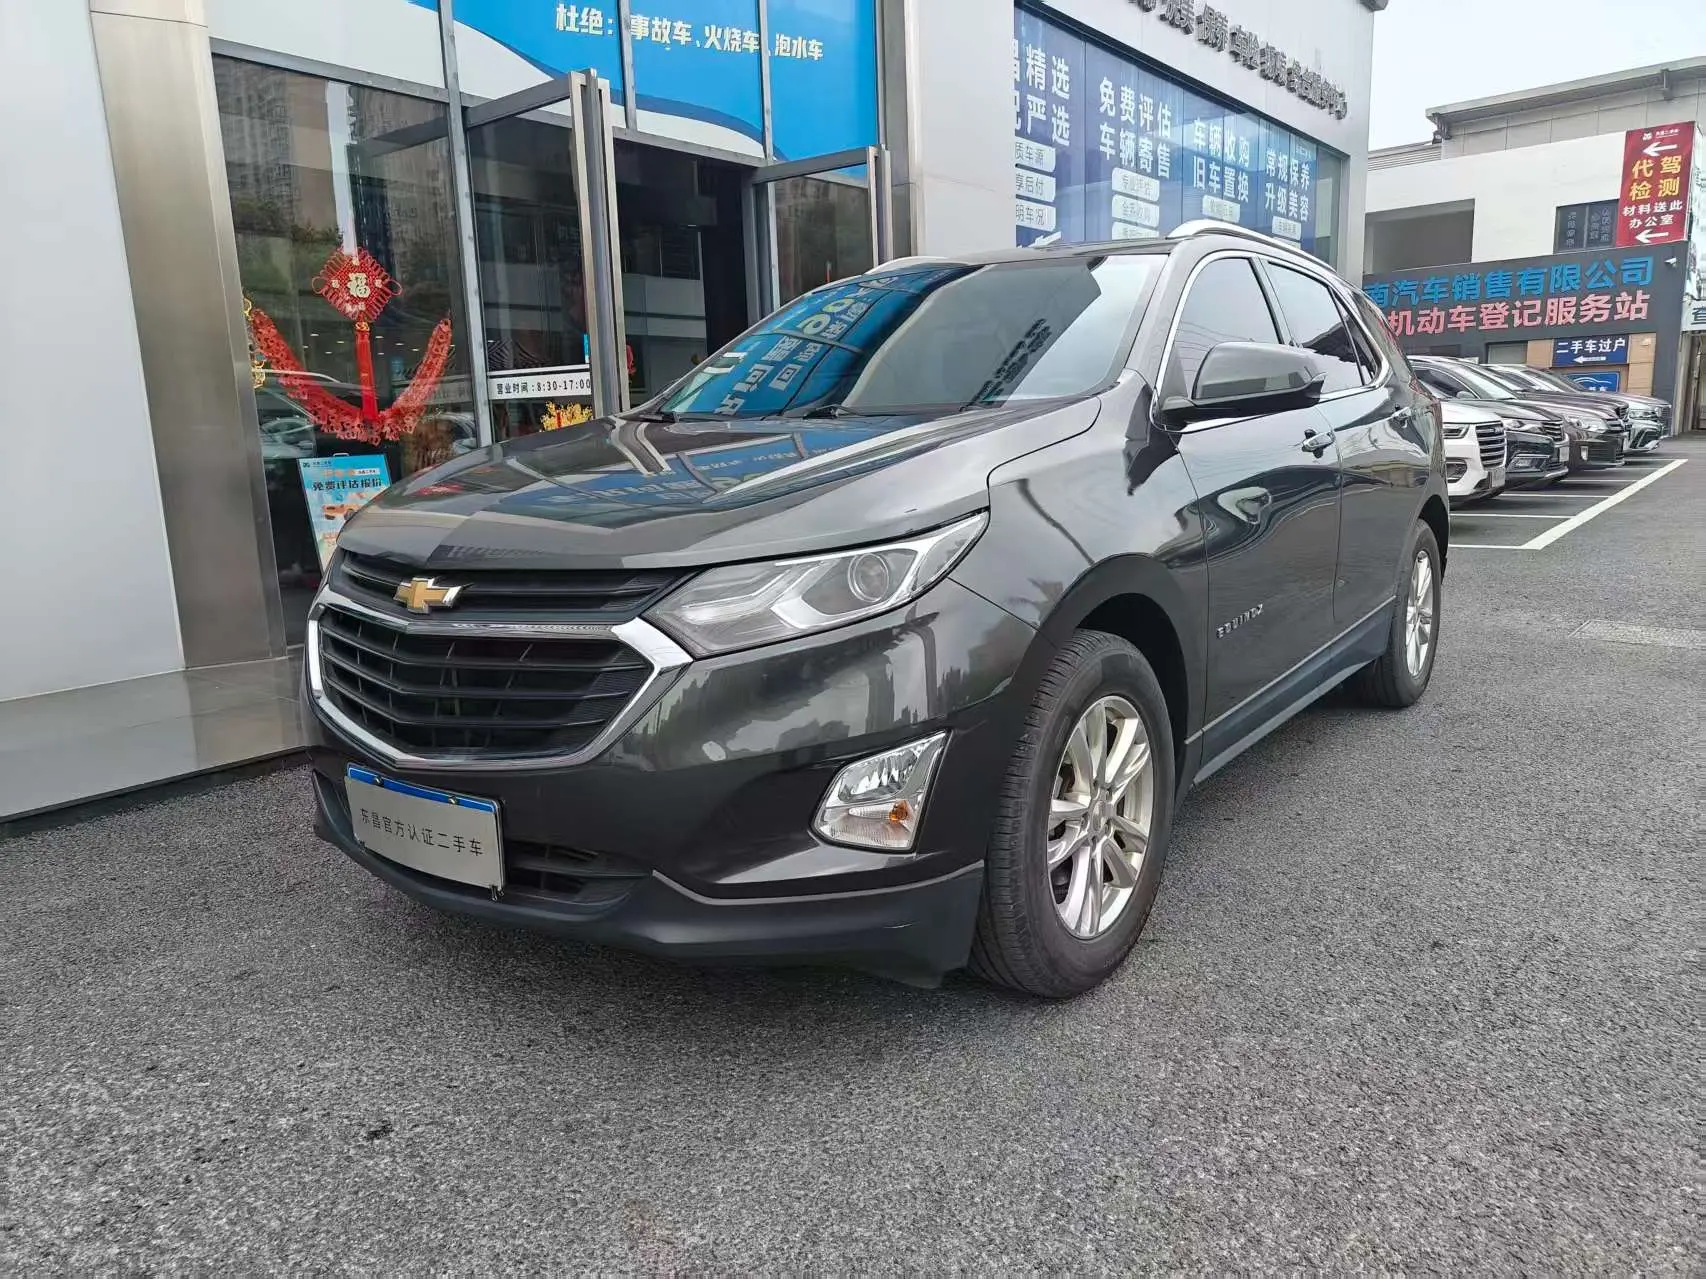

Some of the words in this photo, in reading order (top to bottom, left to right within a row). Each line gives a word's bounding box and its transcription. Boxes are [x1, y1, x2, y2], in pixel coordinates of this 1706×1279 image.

[1013, 39, 1070, 100] 精选
[1099, 76, 1172, 139] 免费评估
[1099, 121, 1171, 180] 车辆寄售
[1193, 116, 1250, 168] 车辆收购
[1193, 155, 1249, 203] 旧车置换
[1266, 146, 1310, 190] 常规保养
[1629, 176, 1681, 201] 检测
[1632, 155, 1682, 179] 代驾
[1265, 182, 1309, 222] 升级美容
[1622, 199, 1684, 217] 材料送此
[1629, 214, 1674, 229] 办公室
[1387, 289, 1651, 338] 机动车登记服务站
[1556, 337, 1626, 355] 二手车过户
[359, 807, 483, 857] 东昌官方认证二手车
